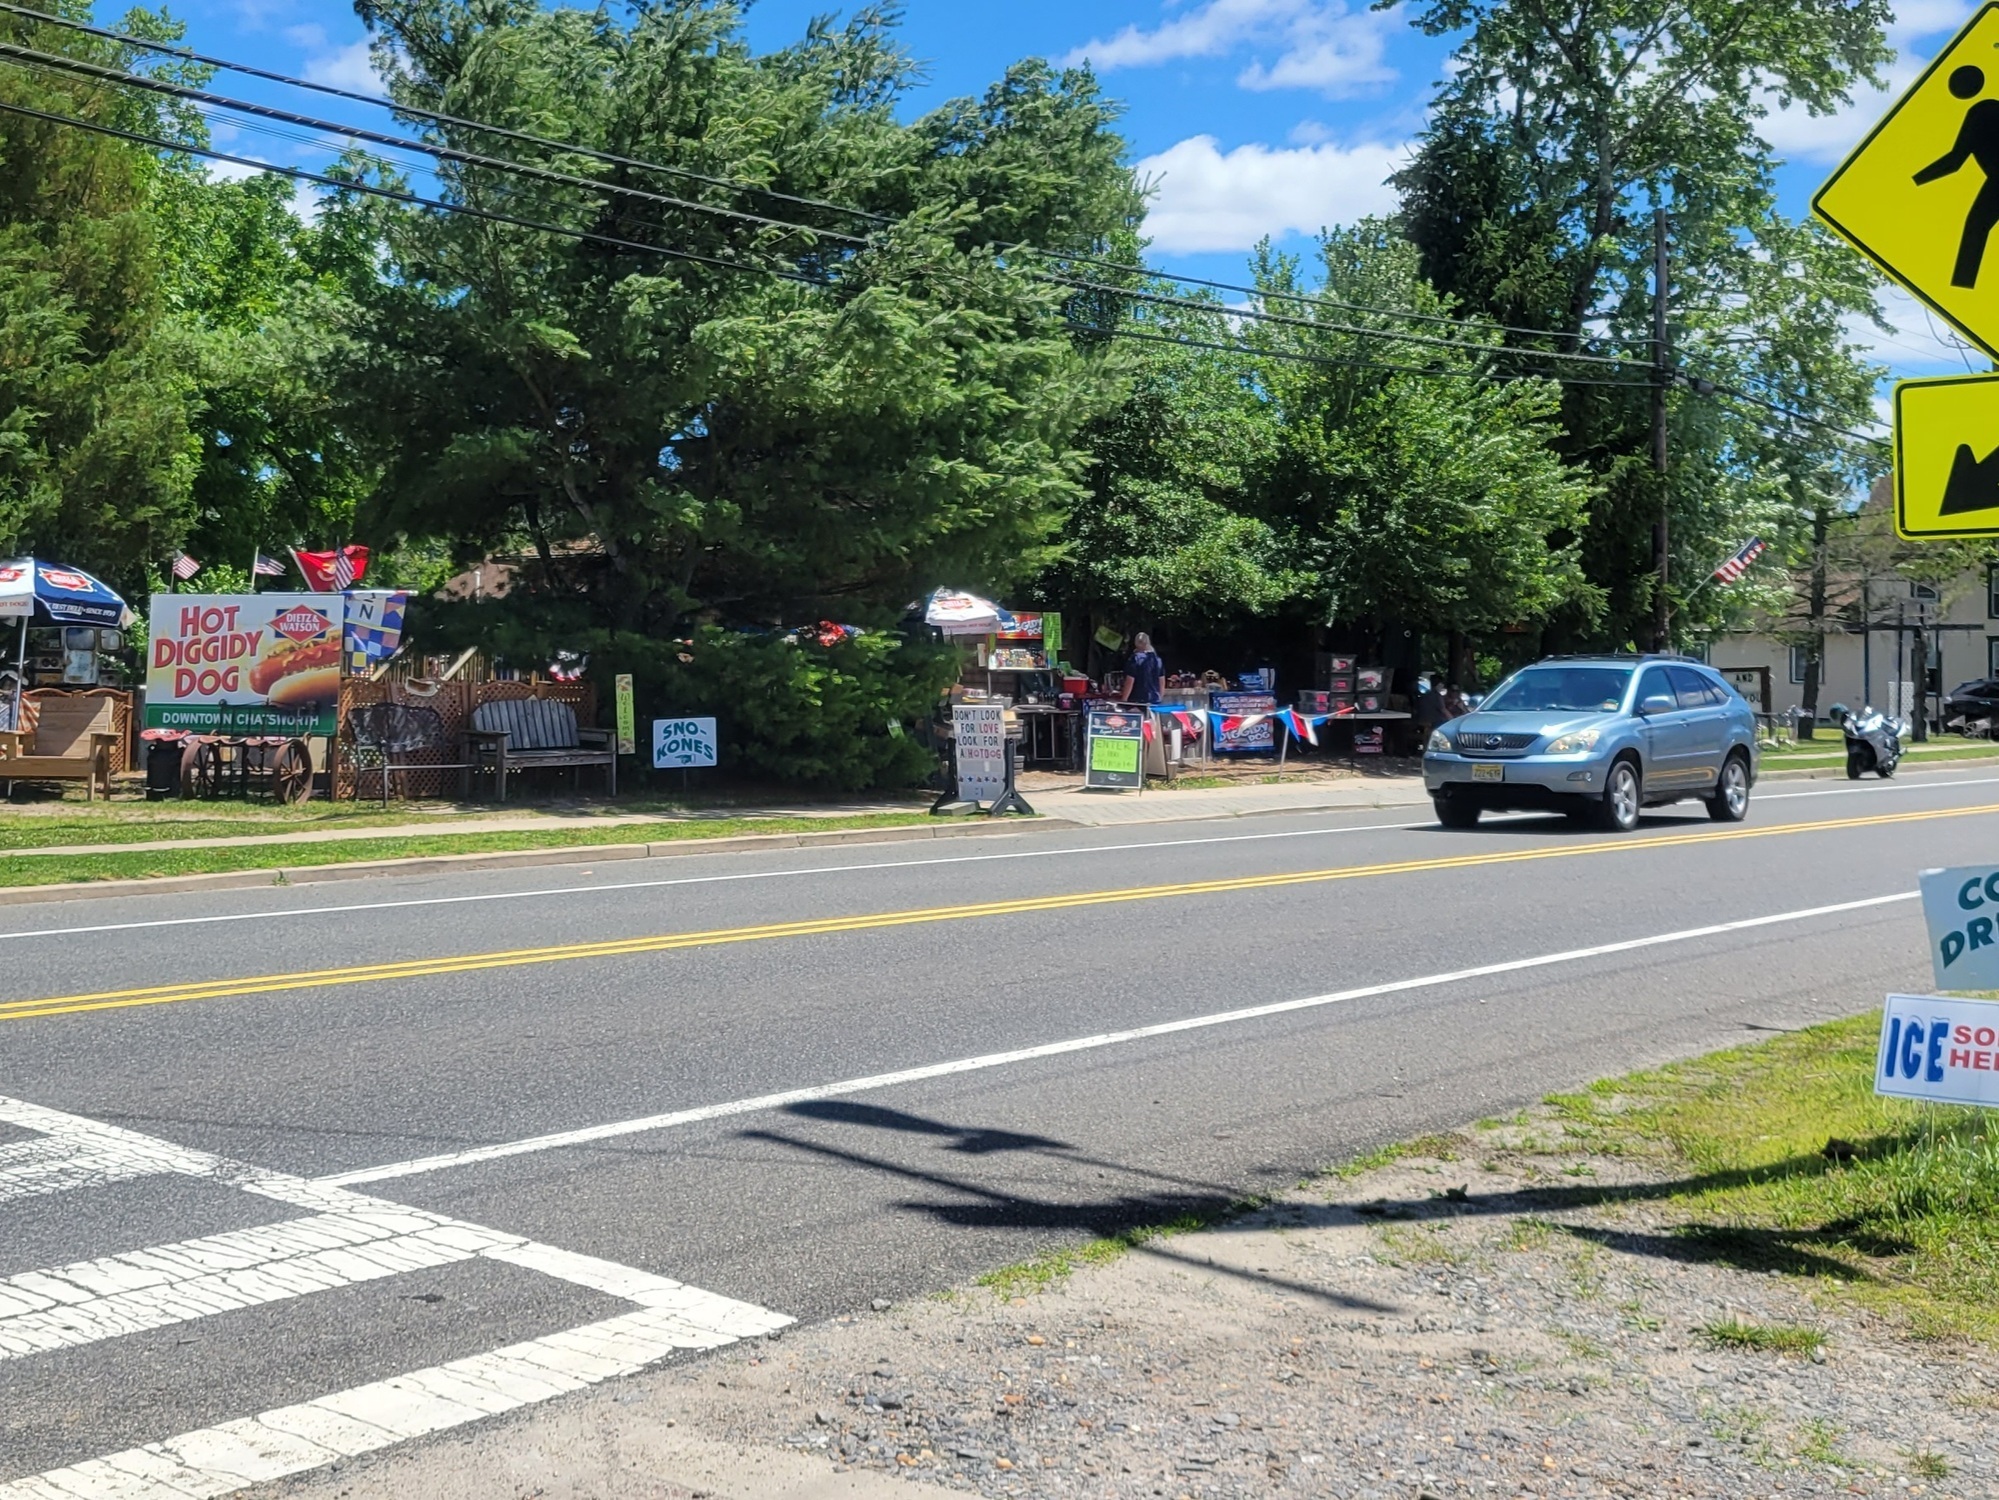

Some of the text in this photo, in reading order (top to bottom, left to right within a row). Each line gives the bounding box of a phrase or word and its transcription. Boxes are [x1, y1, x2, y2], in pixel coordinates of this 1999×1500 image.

[180, 605, 240, 637] HOT
[280, 622, 320, 631] WATSON
[286, 613, 310, 622] DIETZ
[154, 630, 263, 668] DIGGIDY
[175, 666, 239, 698] DOG
[162, 712, 232, 724] DOWNTOWN
[954, 710, 1001, 720] DON'T LOOK
[663, 721, 707, 740] SNO-
[960, 723, 999, 733] FOR LOVE
[656, 738, 714, 762] KONES
[957, 736, 998, 746] LOOK FOR
[1940, 912, 1999, 969] DR
[1953, 1025, 1999, 1046] SO
[1885, 1014, 1950, 1082] ICE
